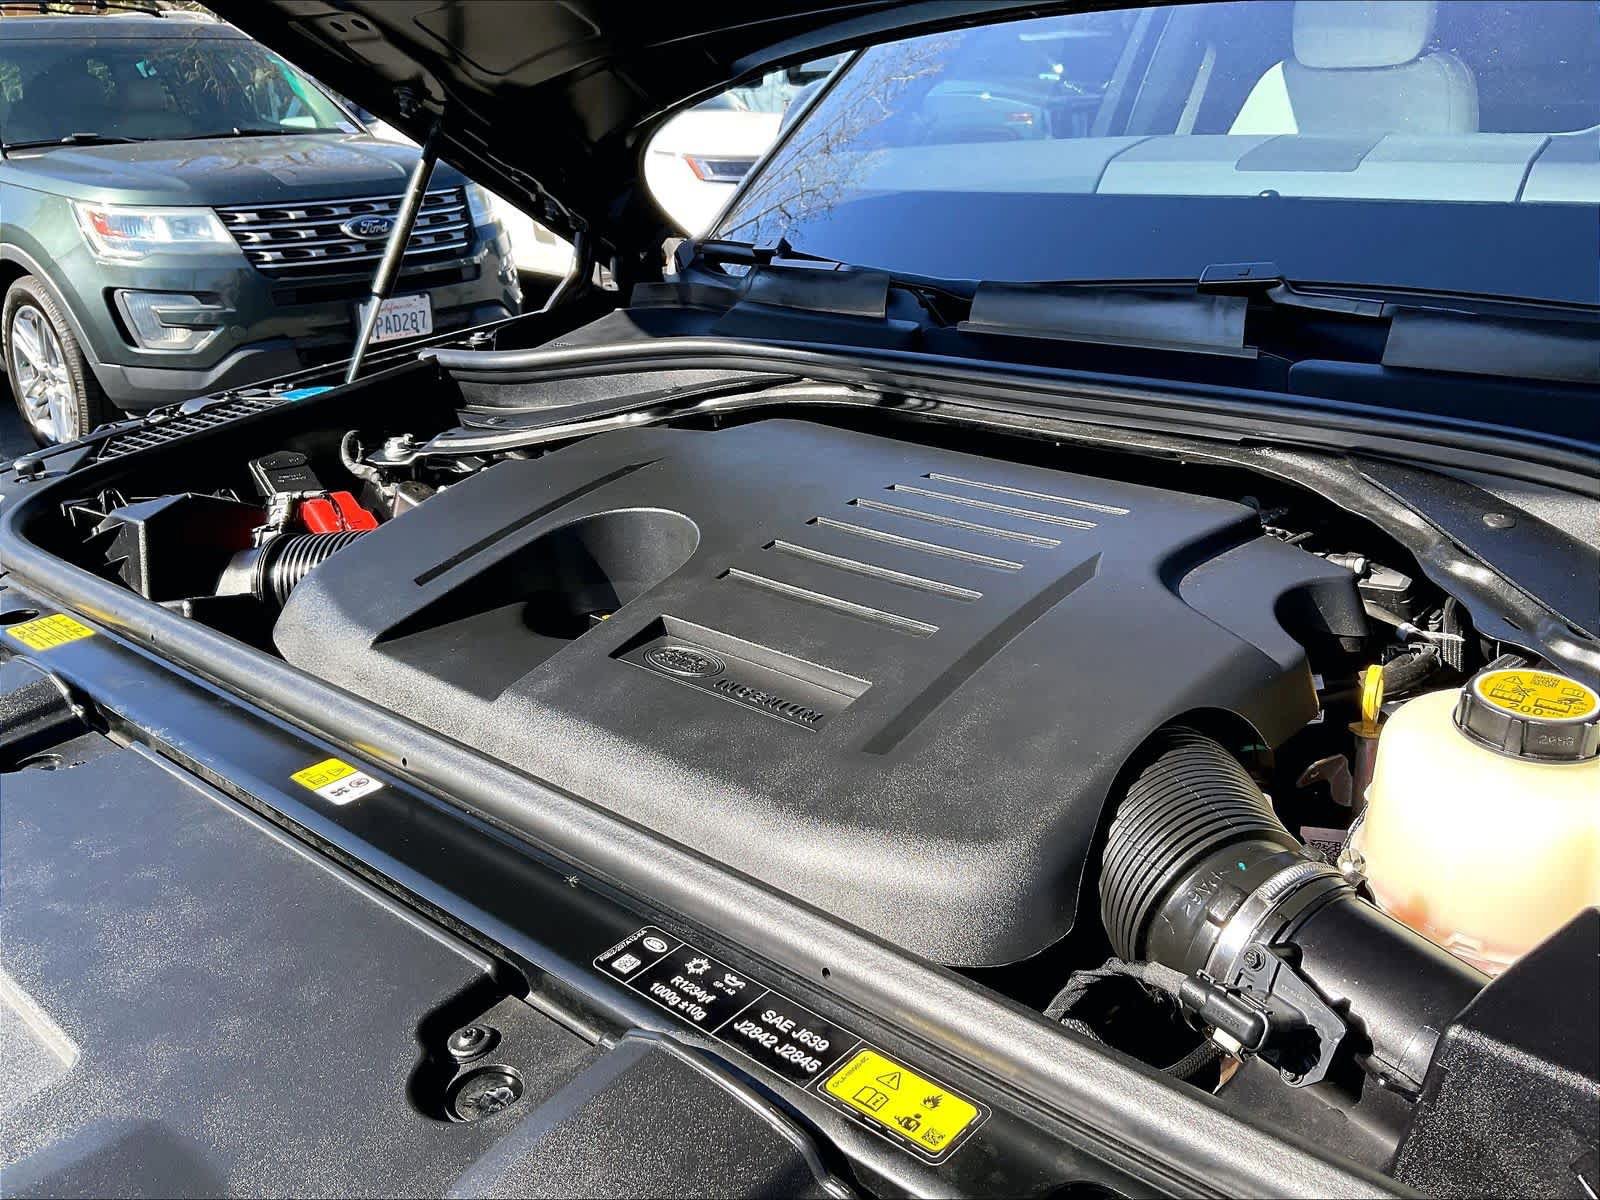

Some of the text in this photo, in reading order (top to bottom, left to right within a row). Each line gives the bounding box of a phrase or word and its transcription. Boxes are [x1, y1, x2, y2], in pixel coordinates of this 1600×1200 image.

[360, 219, 388, 235] Ford
[369, 310, 427, 338] PAD287
[713, 679, 824, 723] INGENIUM
[1507, 702, 1544, 716] 200
[650, 982, 708, 1021] 1000g ±10g
[670, 975, 717, 1004] R1234yf
[733, 1019, 779, 1051] J2842
[774, 1043, 822, 1073] J2845
[760, 1009, 830, 1052] SAE J639
